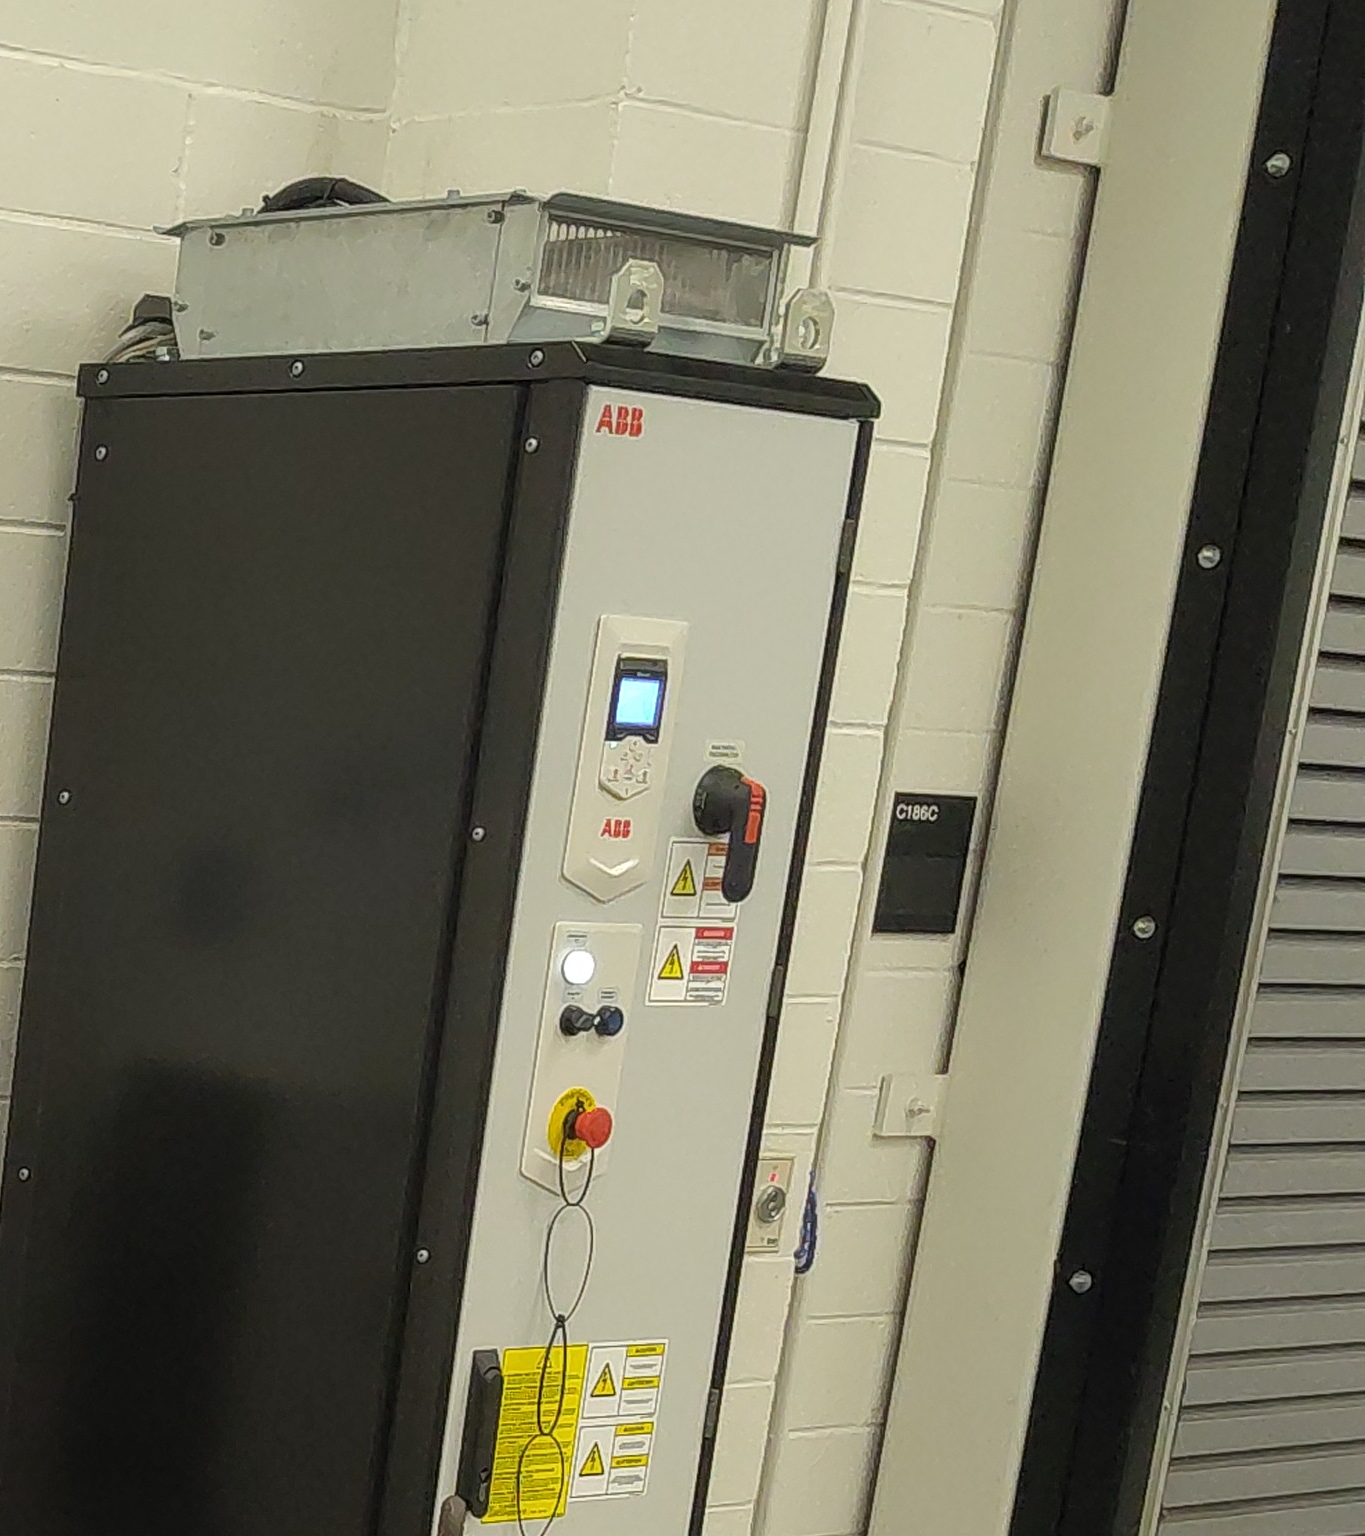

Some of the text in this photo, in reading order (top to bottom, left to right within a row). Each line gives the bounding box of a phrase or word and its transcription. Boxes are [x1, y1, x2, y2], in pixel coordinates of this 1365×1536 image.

[596, 404, 644, 437] ABB
[896, 803, 939, 821] C186C
[600, 818, 631, 838] ABB
